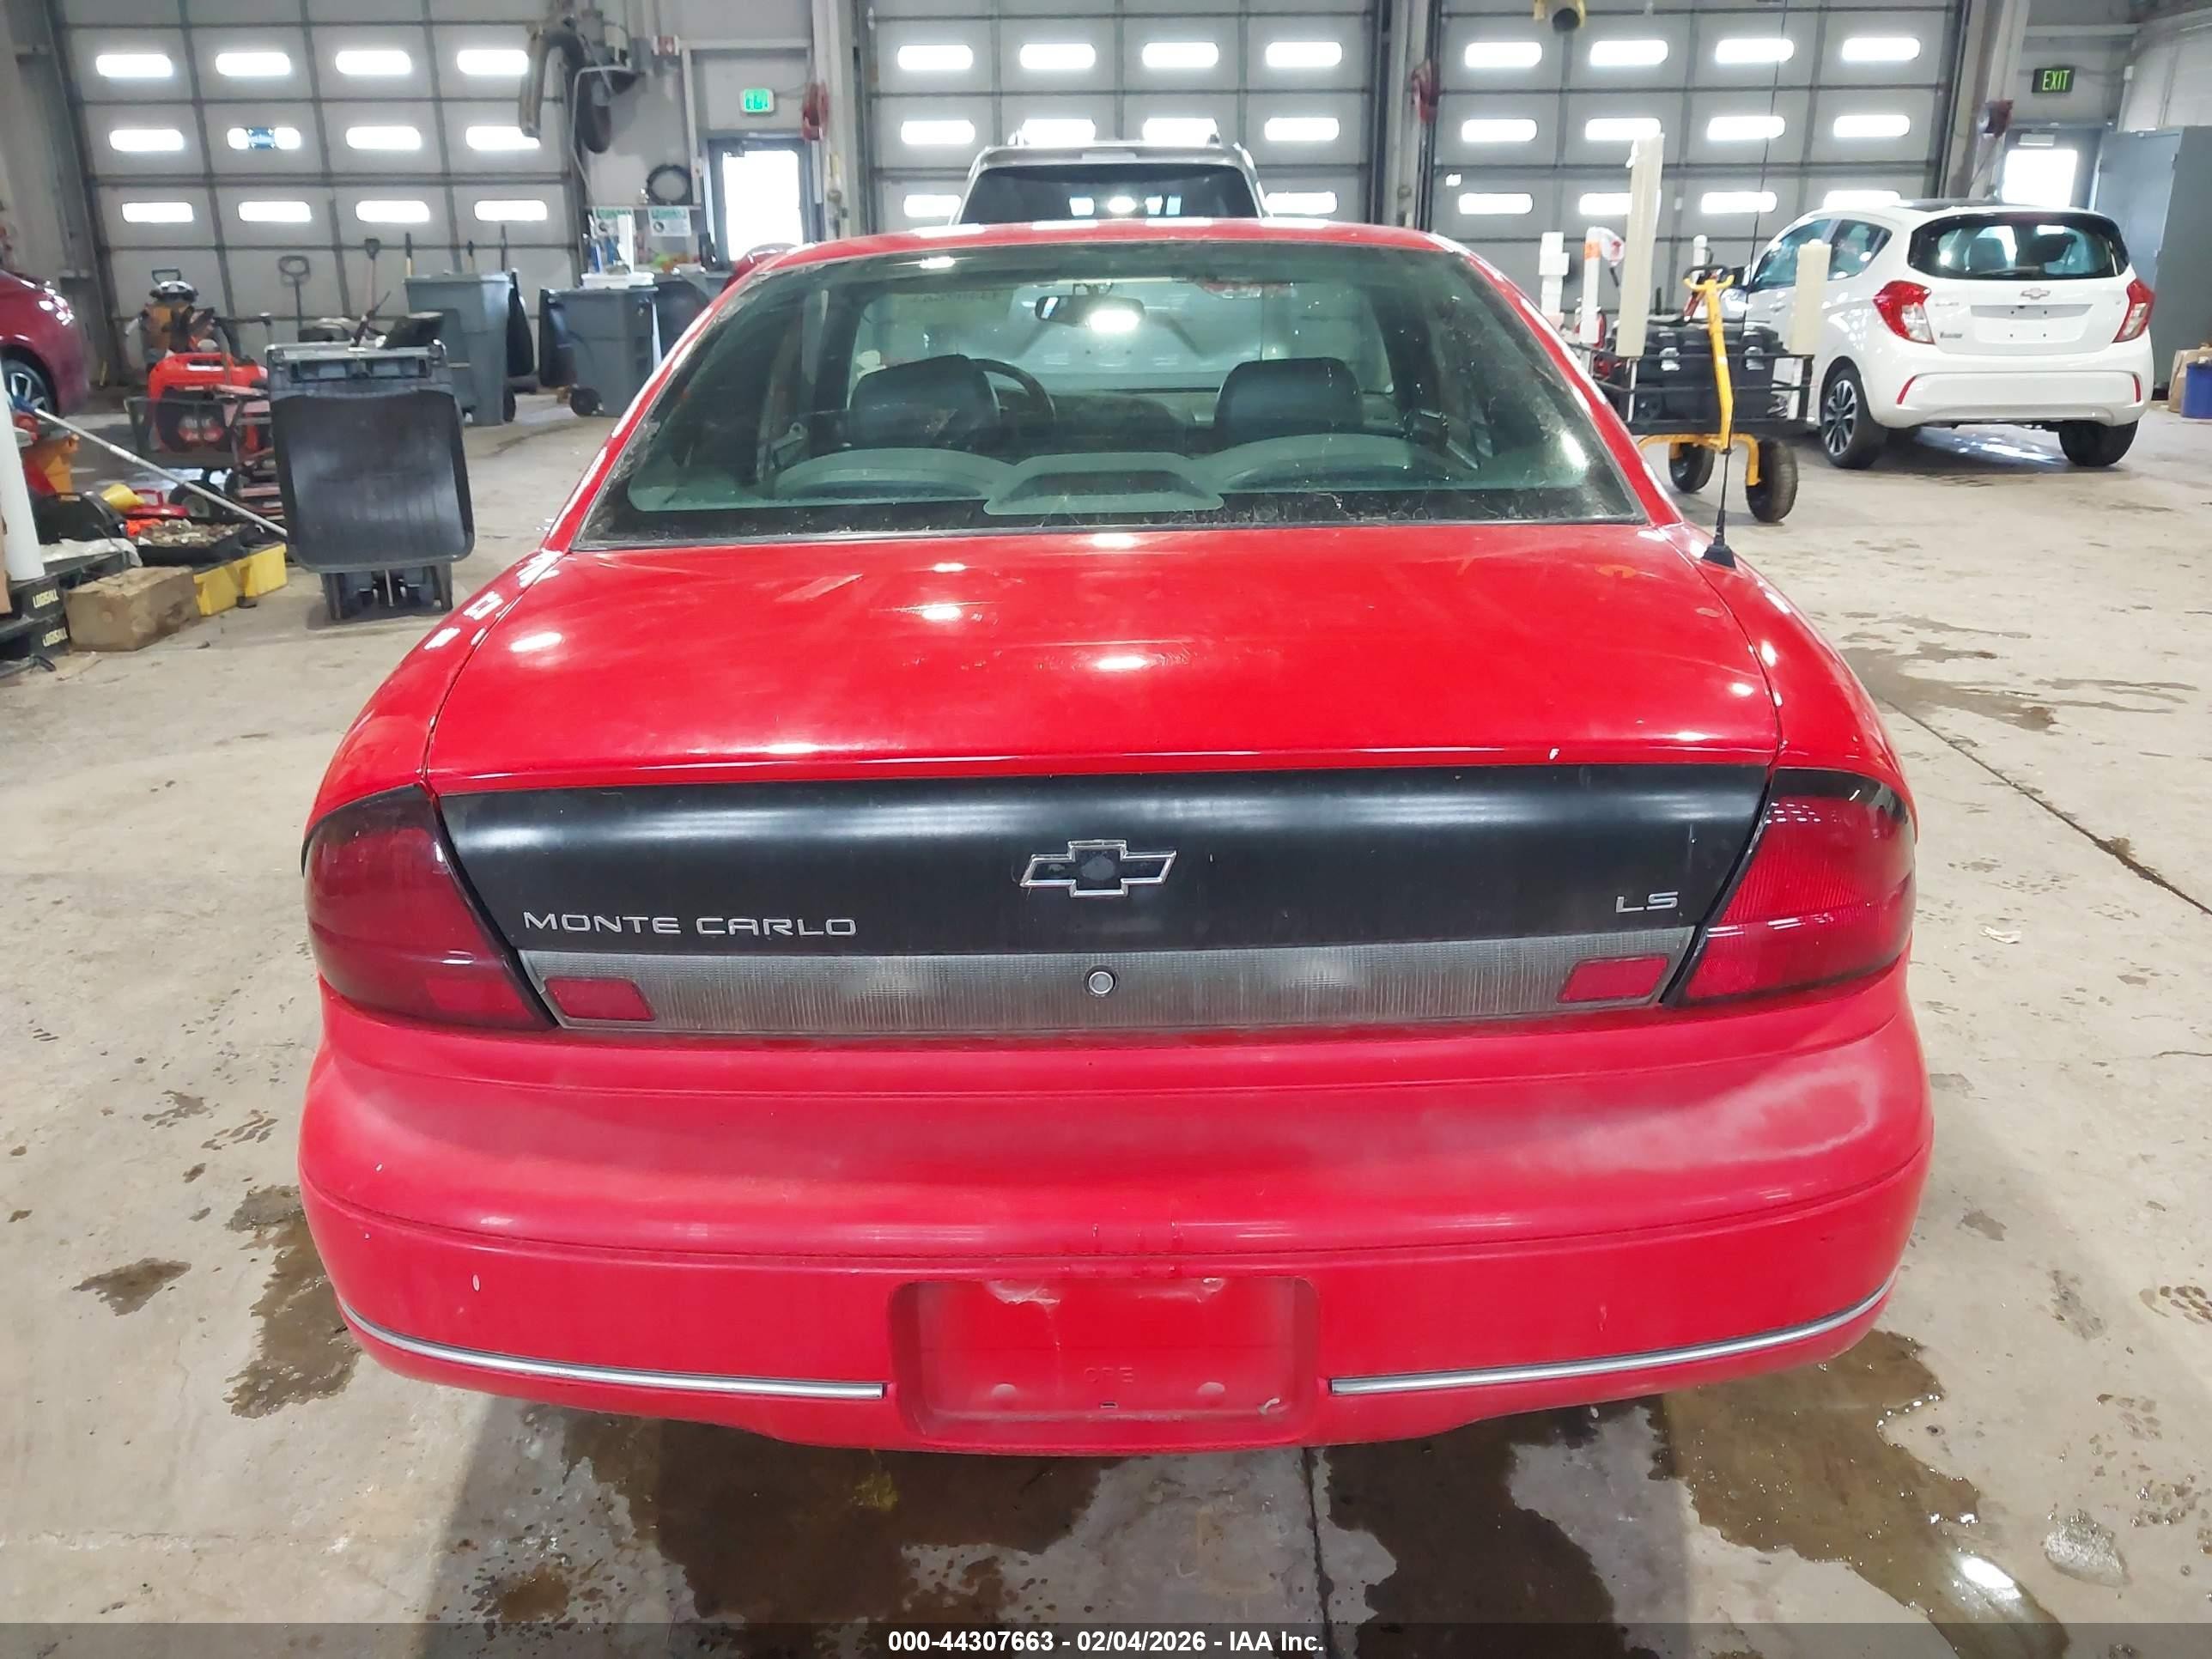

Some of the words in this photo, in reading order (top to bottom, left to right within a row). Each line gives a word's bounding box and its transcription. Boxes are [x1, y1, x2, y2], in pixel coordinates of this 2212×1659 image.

[2042, 70, 2070, 91] EXIT
[1615, 891, 1679, 913] LS
[522, 911, 683, 934] MONTE
[696, 917, 857, 936] CARLO
